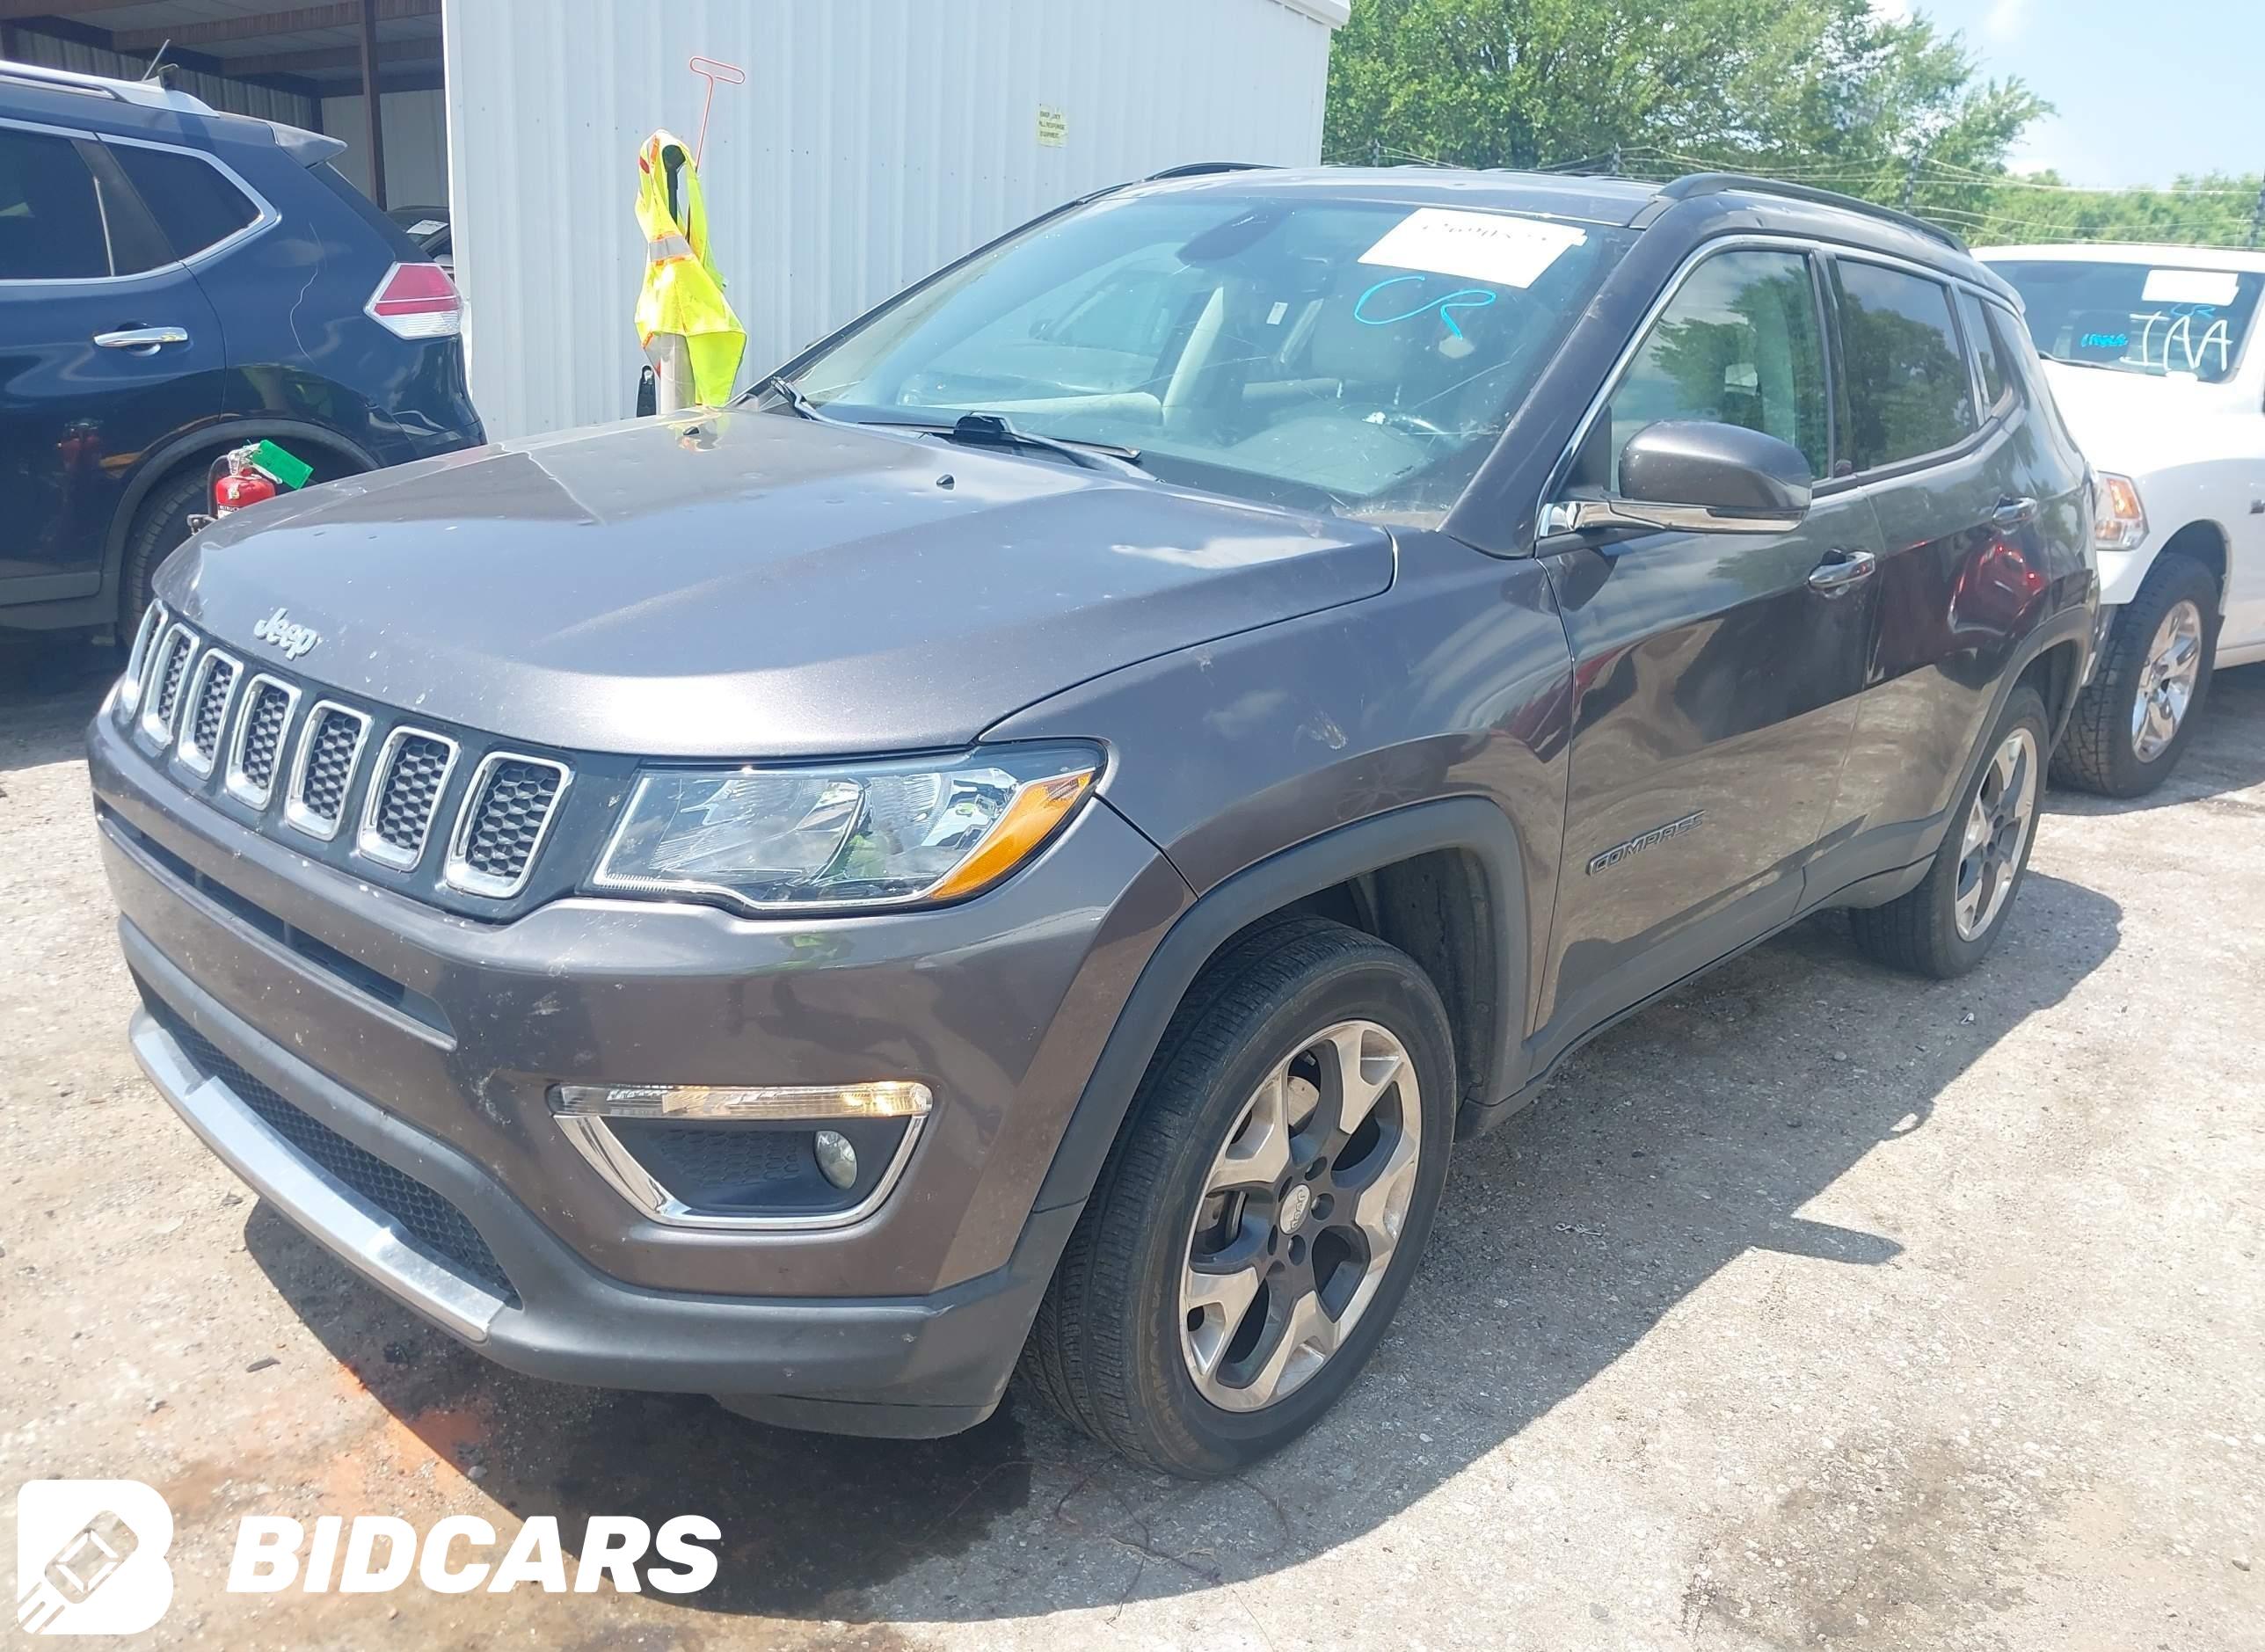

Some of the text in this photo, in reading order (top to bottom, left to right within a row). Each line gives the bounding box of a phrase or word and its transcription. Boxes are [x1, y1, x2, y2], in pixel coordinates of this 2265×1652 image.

[2119, 311, 2233, 372] IAA
[253, 608, 318, 661] Jeep
[1585, 809, 1707, 876] COMPASS
[1290, 1190, 1307, 1230] Jeep
